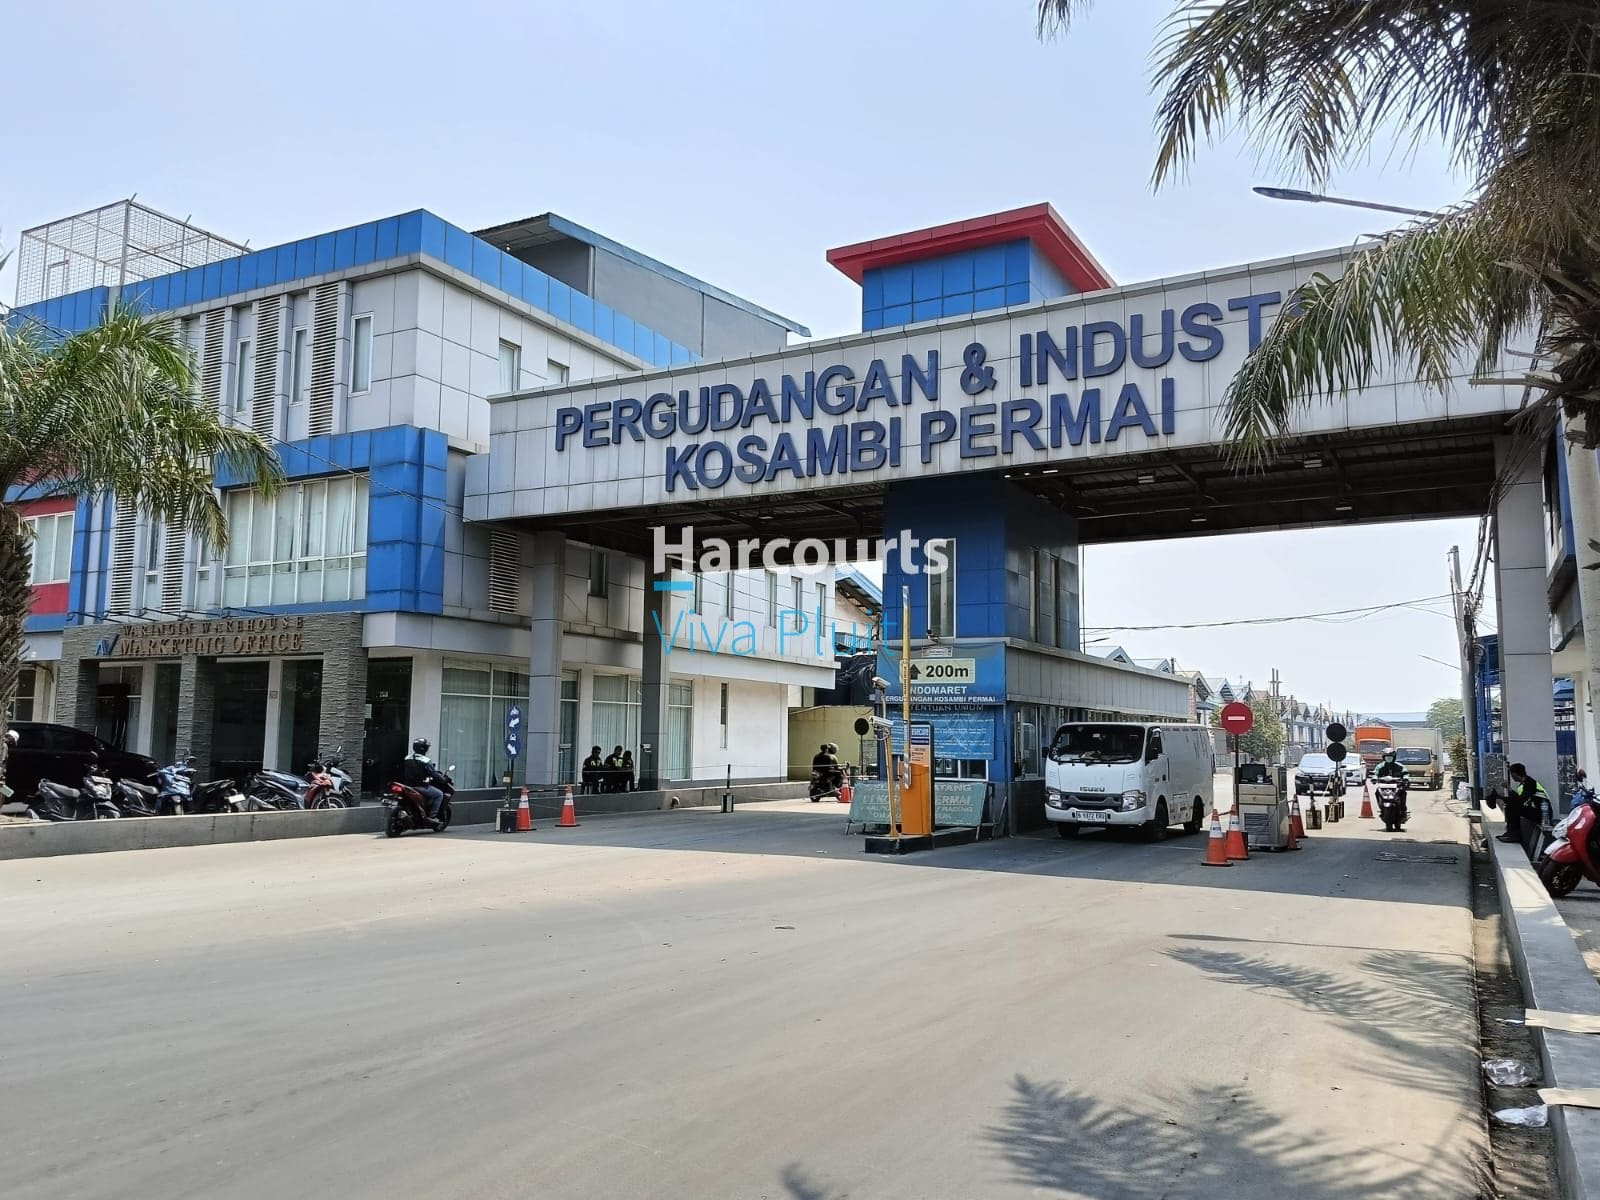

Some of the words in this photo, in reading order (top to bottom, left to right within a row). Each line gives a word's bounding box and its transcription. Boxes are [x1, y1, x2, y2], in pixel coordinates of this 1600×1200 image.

[555, 349, 939, 452] PERGUDANGAN
[960, 342, 997, 395] &
[1020, 289, 1306, 388] INDUST
[665, 416, 901, 493] KOSAMBI
[920, 377, 1175, 465] PERMAI
[202, 616, 304, 635] WAREHOUSE
[120, 636, 226, 657] MARKETING
[233, 632, 304, 653] OFFICE
[925, 664, 969, 678] 200m
[910, 686, 968, 695] NDOMARET
